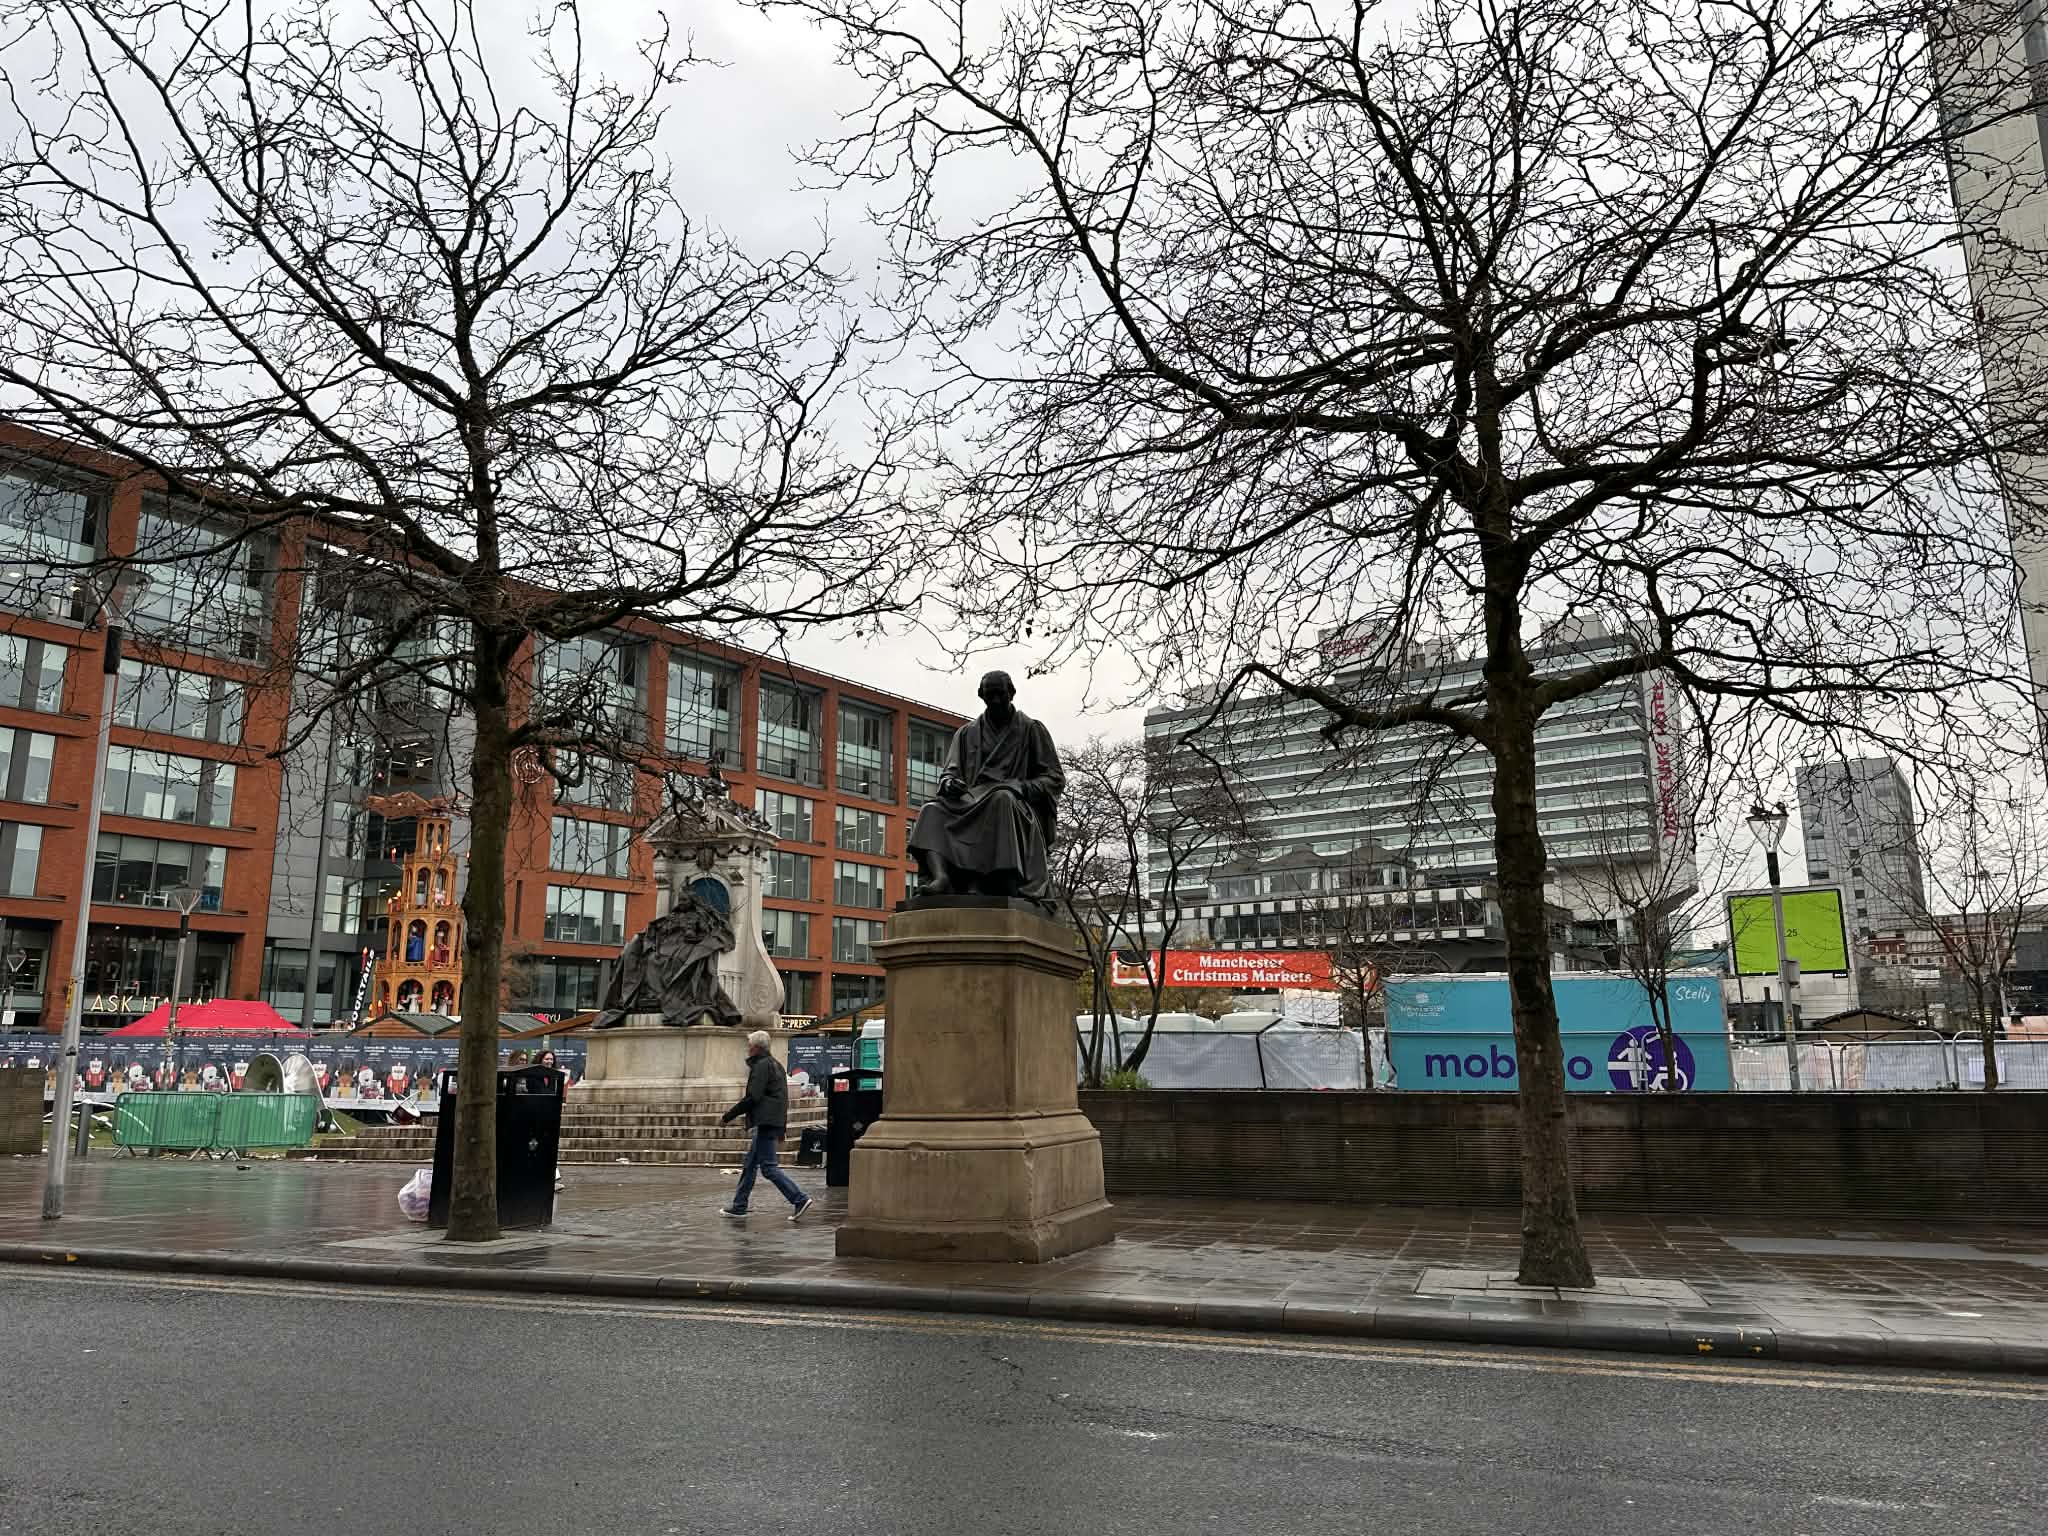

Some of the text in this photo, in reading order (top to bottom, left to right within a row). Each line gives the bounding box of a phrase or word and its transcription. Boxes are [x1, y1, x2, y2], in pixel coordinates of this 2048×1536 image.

[1199, 955, 1285, 968] Manchester
[1173, 969, 1312, 983] Christmas Markets
[90, 994, 133, 1012] ASK
[1425, 1045, 1593, 1080] mobo
